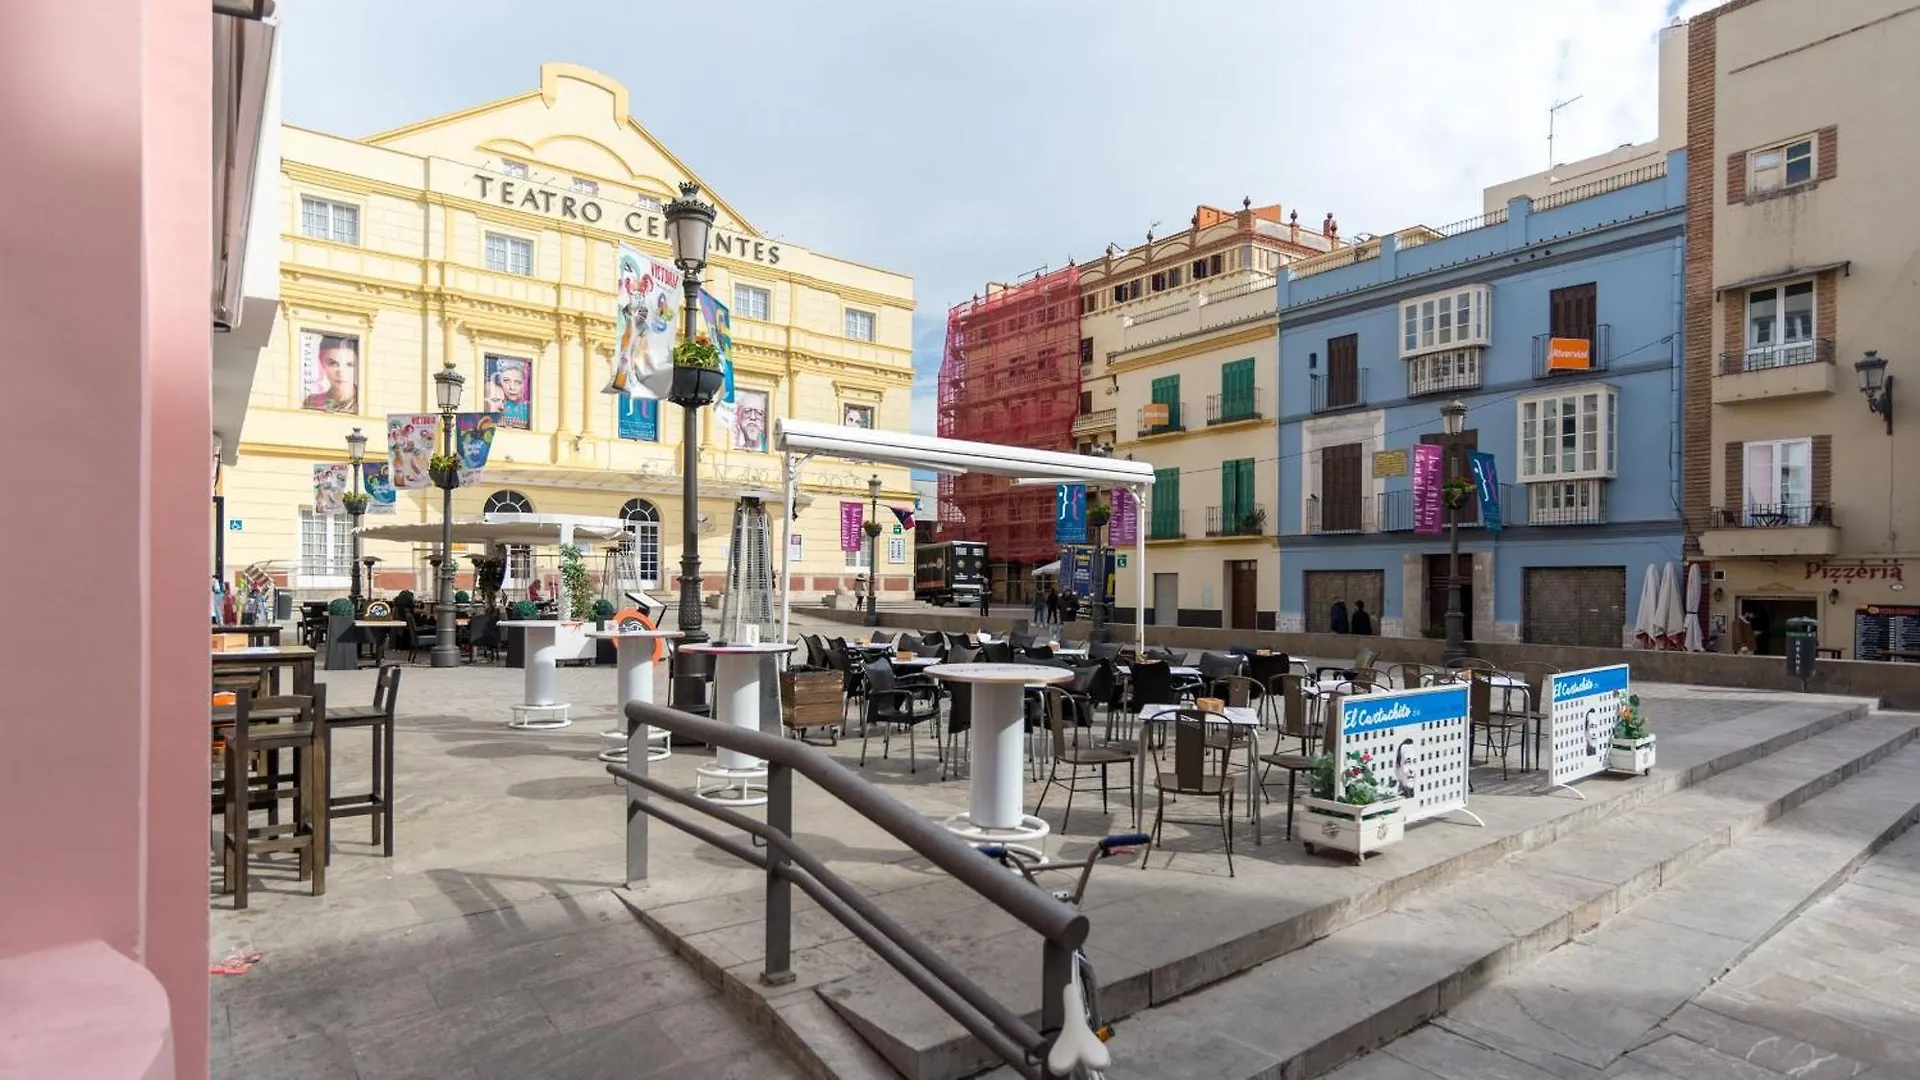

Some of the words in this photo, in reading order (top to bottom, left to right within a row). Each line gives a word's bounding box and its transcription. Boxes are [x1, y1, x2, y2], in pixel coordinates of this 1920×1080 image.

[473, 174, 603, 223] TEATRO
[624, 212, 781, 265] CENTES
[1554, 681, 1562, 698] El
[1343, 708, 1357, 729] El
